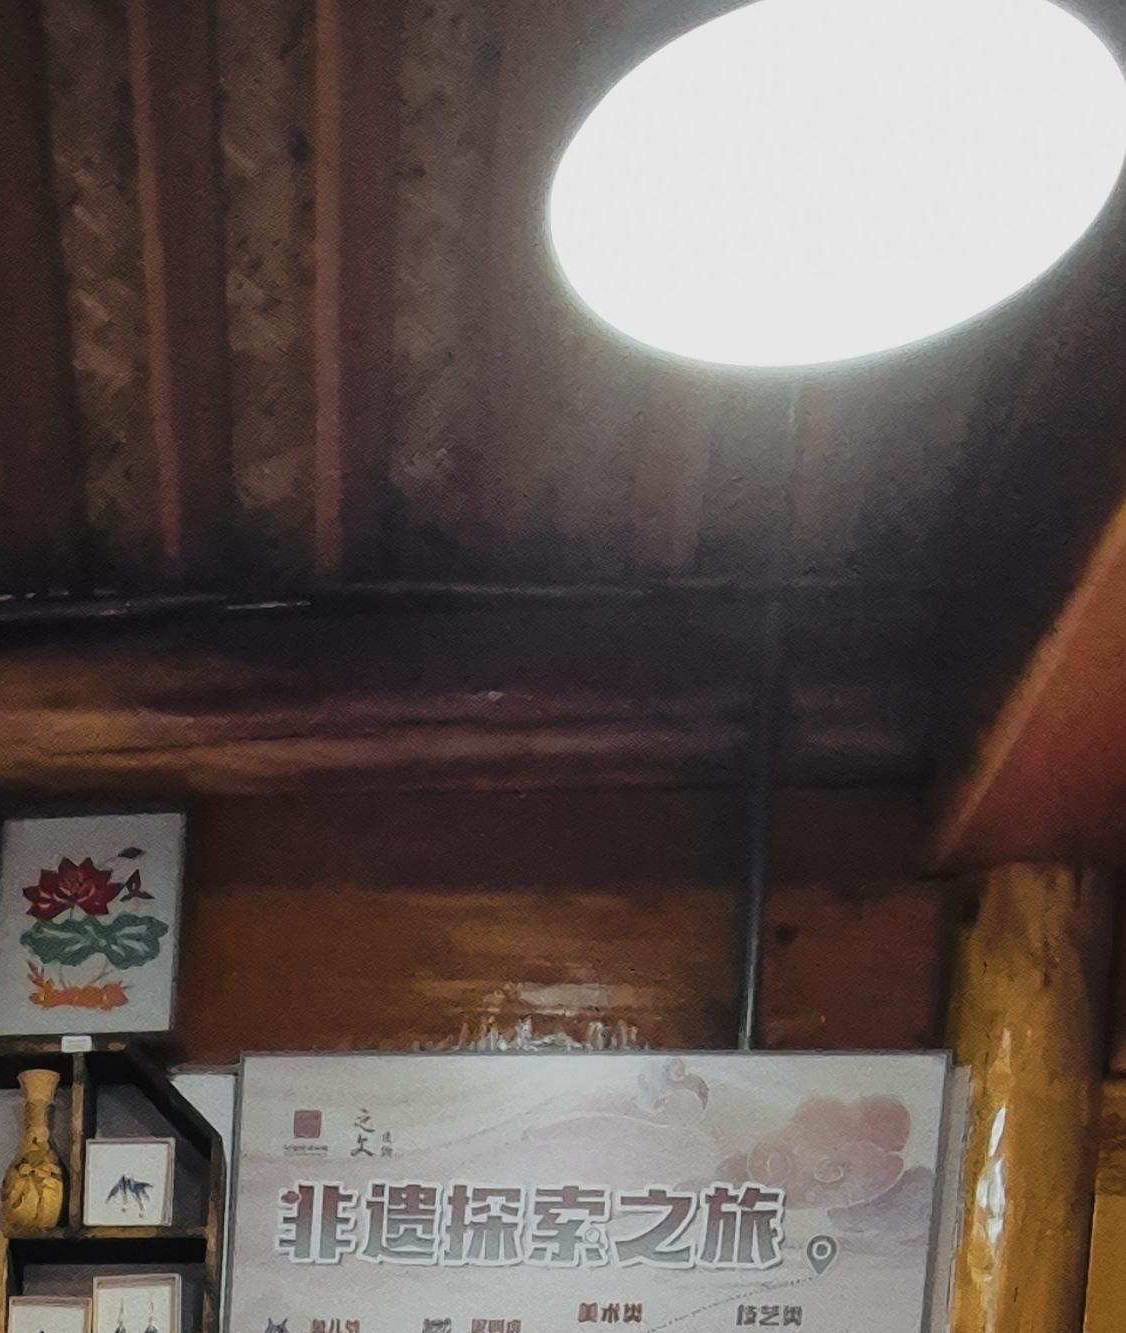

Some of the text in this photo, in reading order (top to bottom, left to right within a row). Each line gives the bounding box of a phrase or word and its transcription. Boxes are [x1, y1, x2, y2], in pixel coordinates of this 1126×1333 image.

[278, 1183, 784, 1268] 非遗探索之旅
